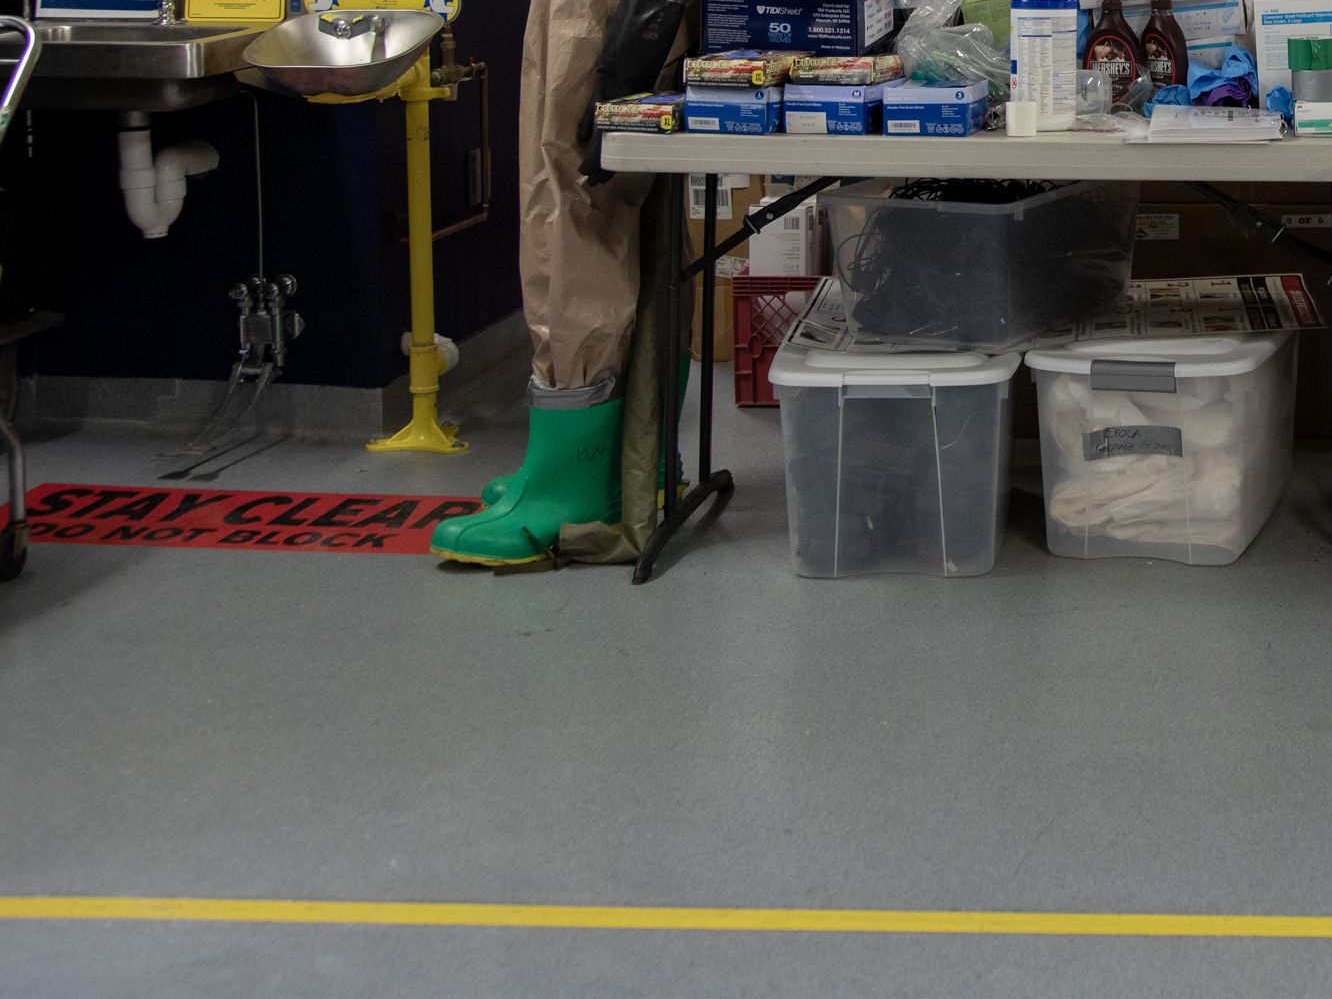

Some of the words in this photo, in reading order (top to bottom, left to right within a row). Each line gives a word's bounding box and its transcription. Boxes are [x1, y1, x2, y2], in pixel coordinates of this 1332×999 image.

[765, 6, 801, 15] TIDIShield
[769, 23, 791, 32] 50
[1092, 63, 1131, 75] HERSHEY'S
[663, 118, 670, 127] XL
[1105, 428, 1141, 438] EBOLA
[27, 489, 230, 522] STAY
[222, 496, 486, 530] CLEAR
[29, 522, 96, 539] DO
[99, 526, 218, 542] NOT
[217, 529, 398, 548] BLOCK
